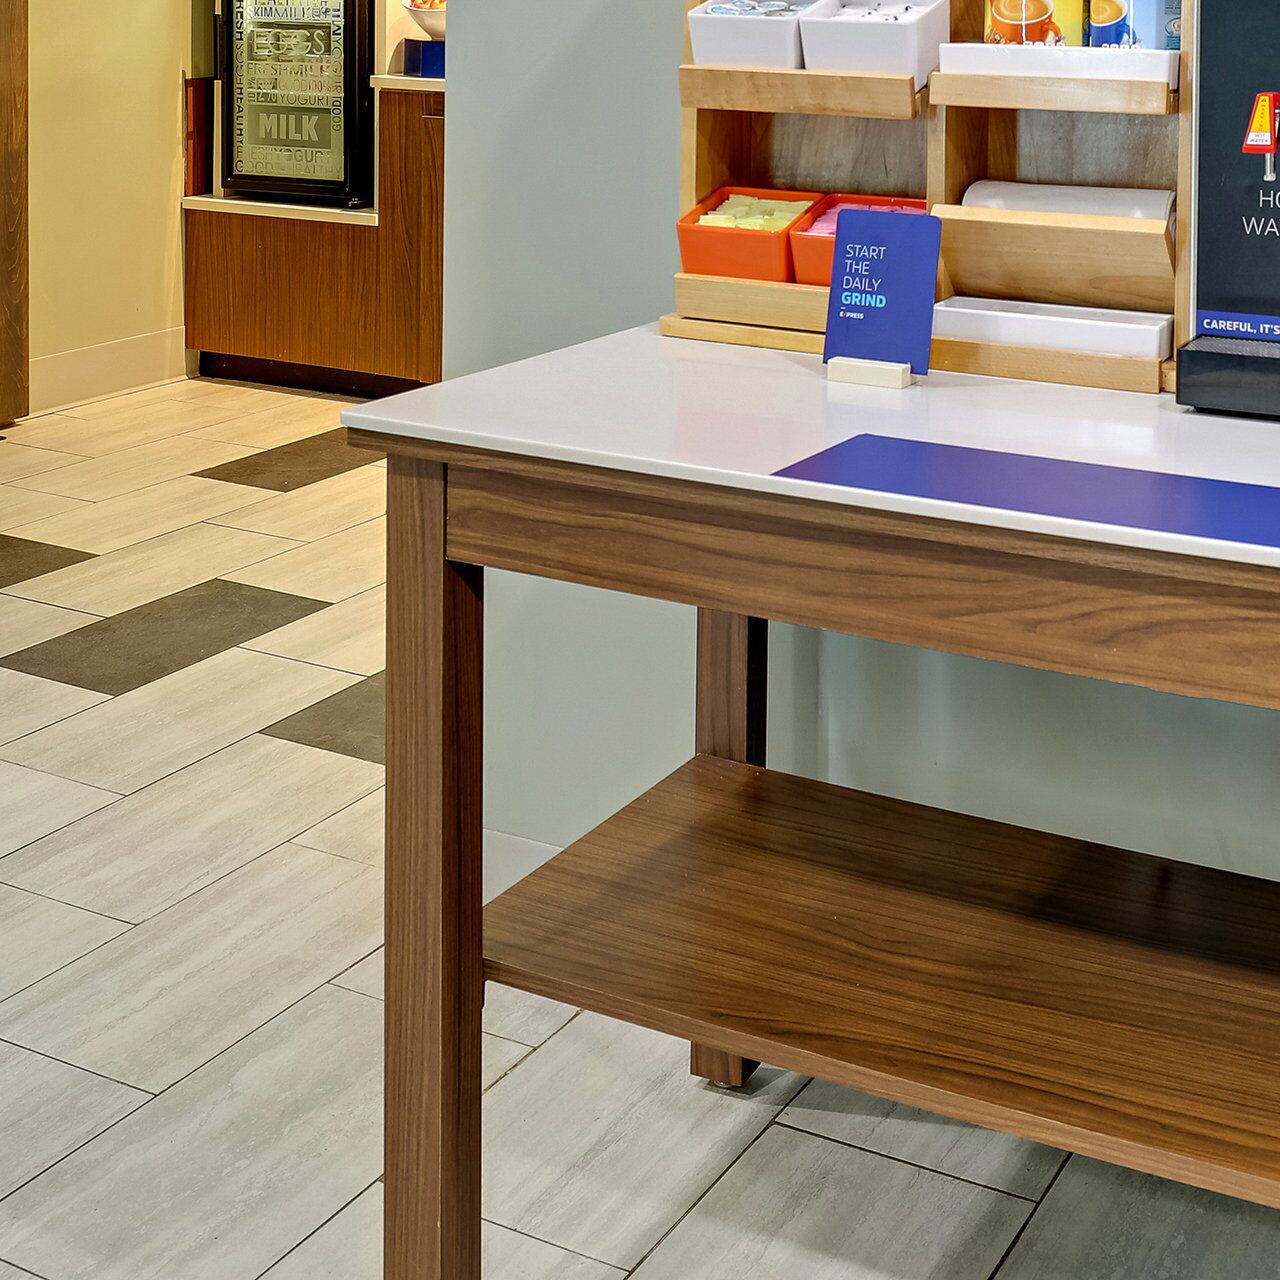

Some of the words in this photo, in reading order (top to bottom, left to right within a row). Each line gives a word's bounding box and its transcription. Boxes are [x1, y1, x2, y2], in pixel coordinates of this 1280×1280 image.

[258, 113, 320, 142] MILK
[845, 244, 887, 259] START
[844, 260, 870, 275] THE
[842, 276, 882, 291] DAILY
[840, 291, 887, 308] GRIND
[1203, 318, 1257, 334] CAREFUL,
[1259, 324, 1280, 335] IT'S
